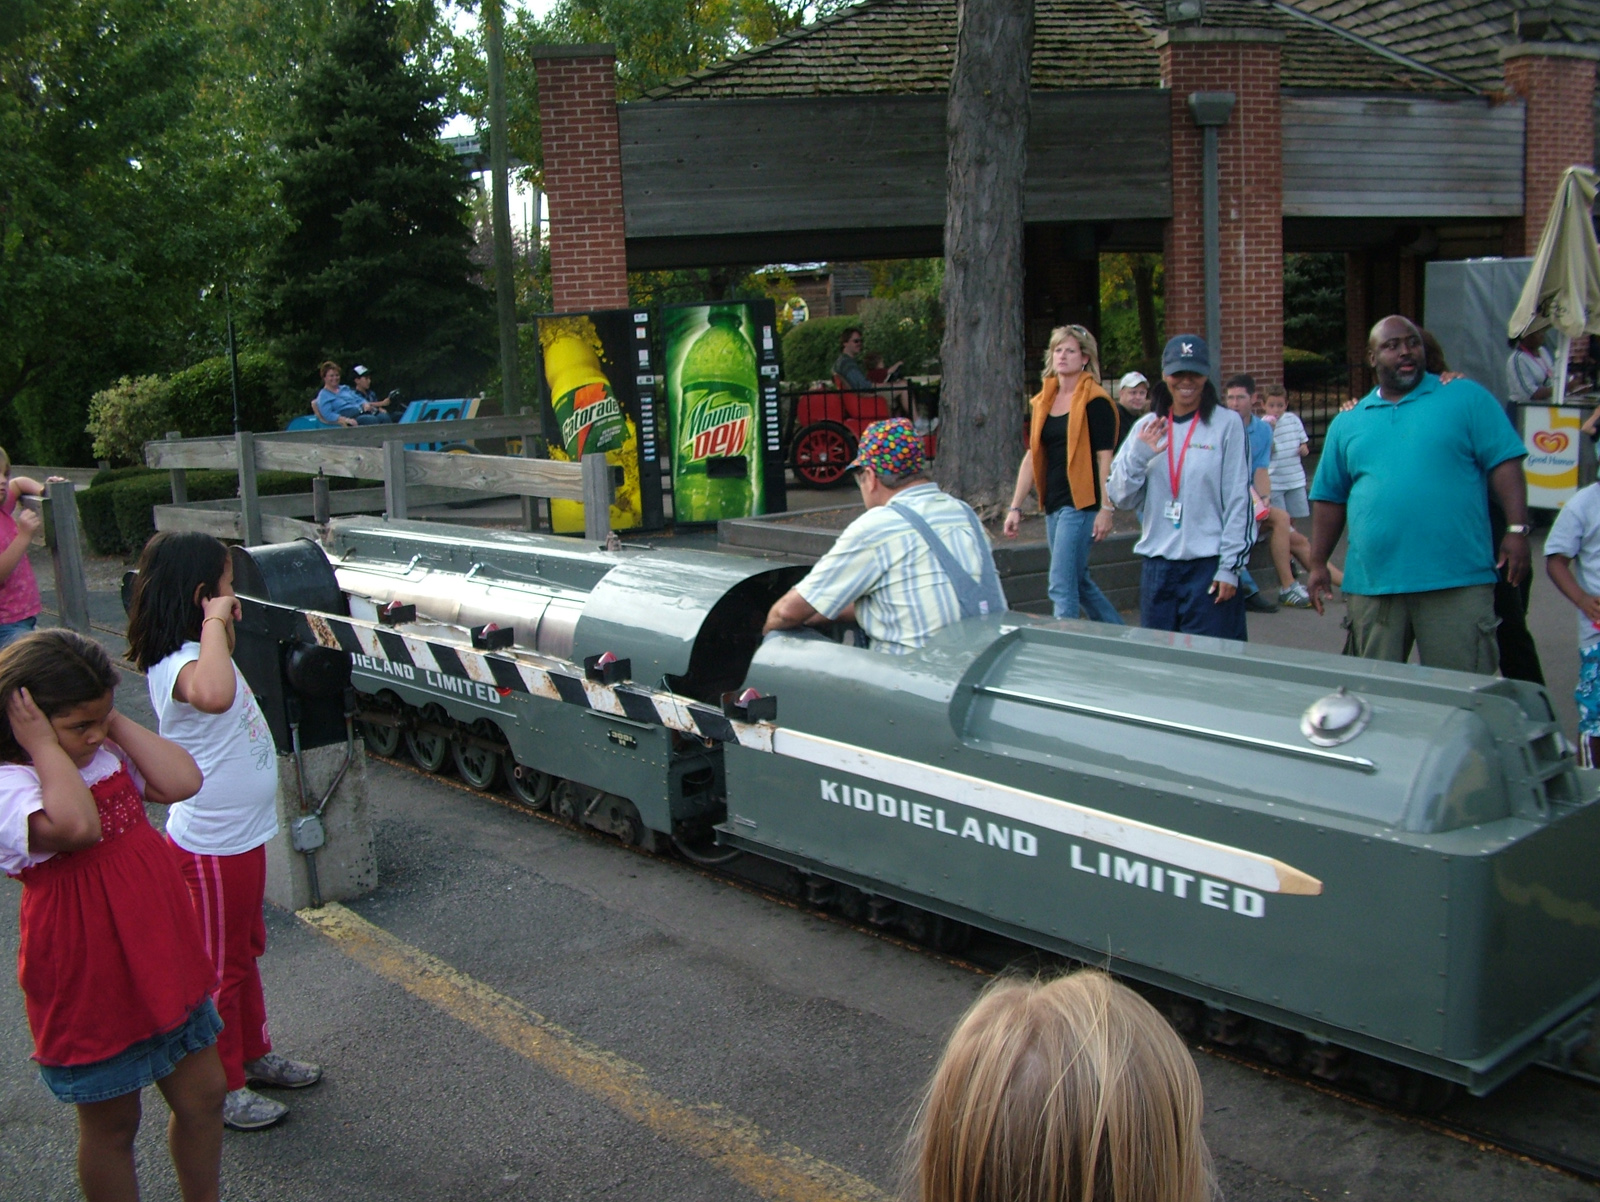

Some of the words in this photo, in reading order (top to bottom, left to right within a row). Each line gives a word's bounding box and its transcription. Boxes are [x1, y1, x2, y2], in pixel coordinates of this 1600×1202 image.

[563, 397, 620, 448] Gatorade
[1528, 455, 1548, 467] Good
[426, 671, 501, 704] LIMITED
[820, 779, 1038, 857] KIDDIELAND
[1070, 845, 1265, 918] LIMITED
